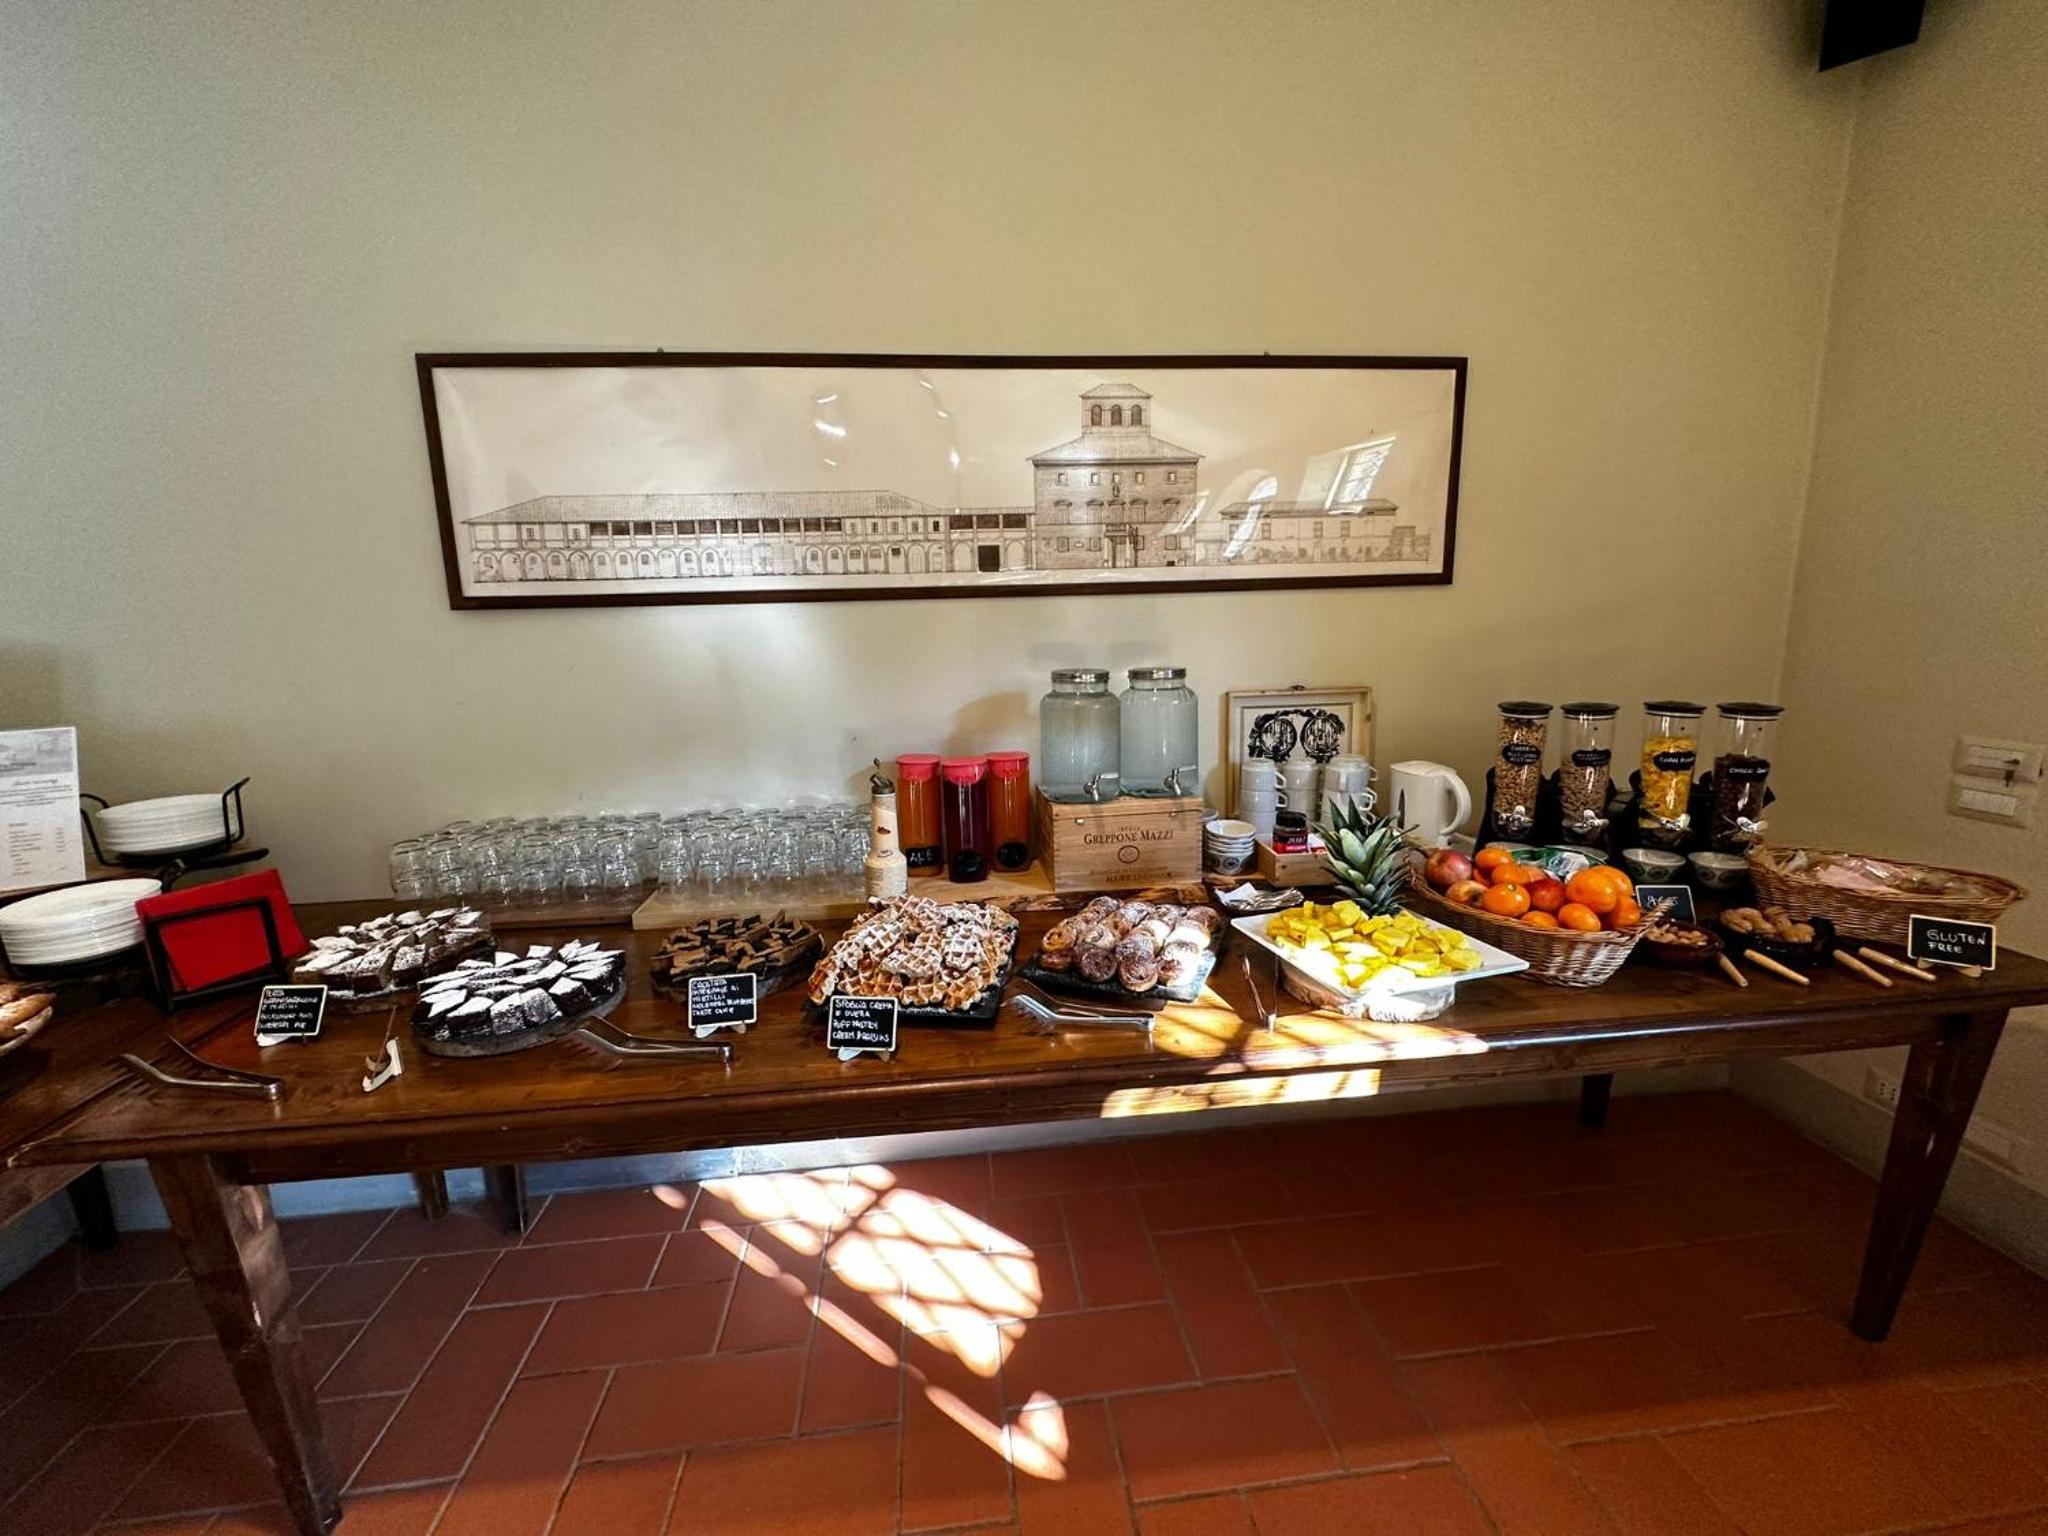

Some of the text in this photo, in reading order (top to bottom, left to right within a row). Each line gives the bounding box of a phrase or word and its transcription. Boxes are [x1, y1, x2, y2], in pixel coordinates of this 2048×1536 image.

[1083, 830, 1174, 844] GREPPONE MAZZI
[1927, 929, 1986, 945] GLUTEN
[1927, 941, 1964, 954] FREE
